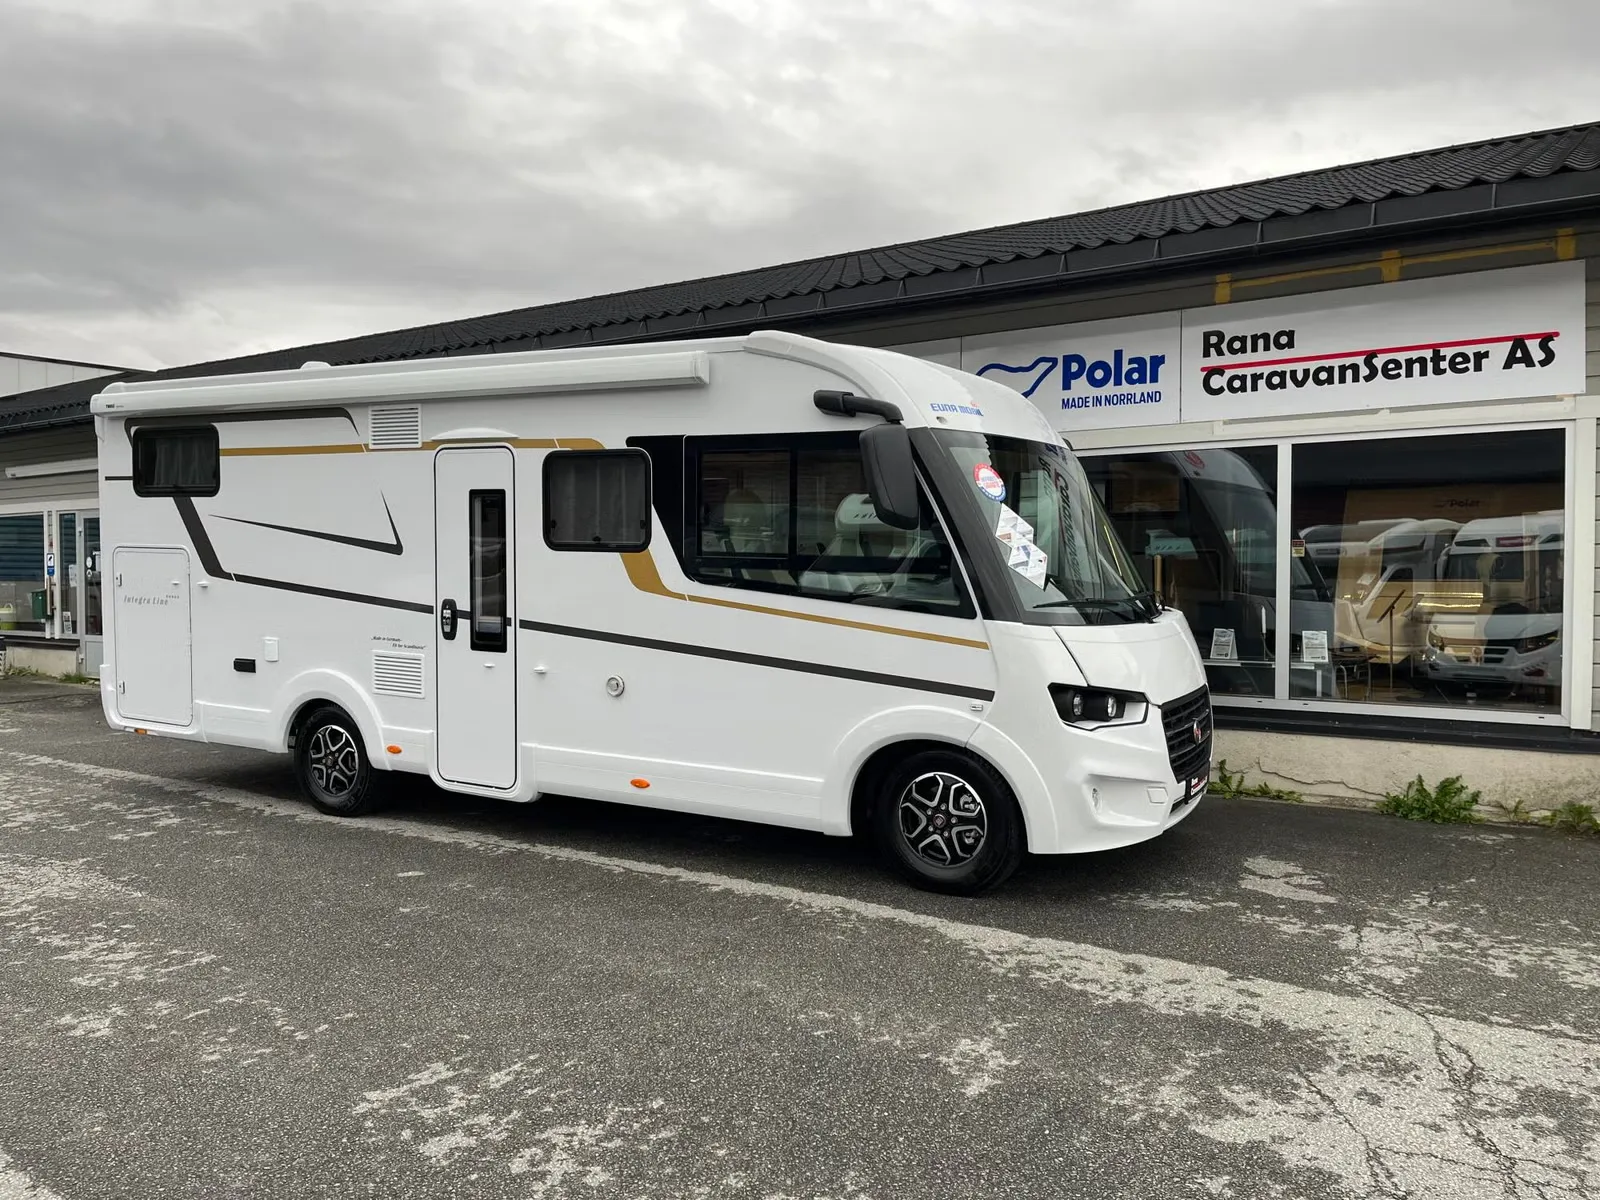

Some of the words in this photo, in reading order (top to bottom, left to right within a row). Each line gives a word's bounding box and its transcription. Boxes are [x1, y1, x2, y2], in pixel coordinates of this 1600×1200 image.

[1202, 329, 1295, 358] Rana
[1062, 349, 1165, 391] Polar
[1202, 348, 1490, 396] CaravanSenter
[1502, 334, 1556, 370] AS
[1062, 396, 1090, 410] MADE
[1092, 395, 1102, 408] IN
[1104, 390, 1162, 407] NORRLAND
